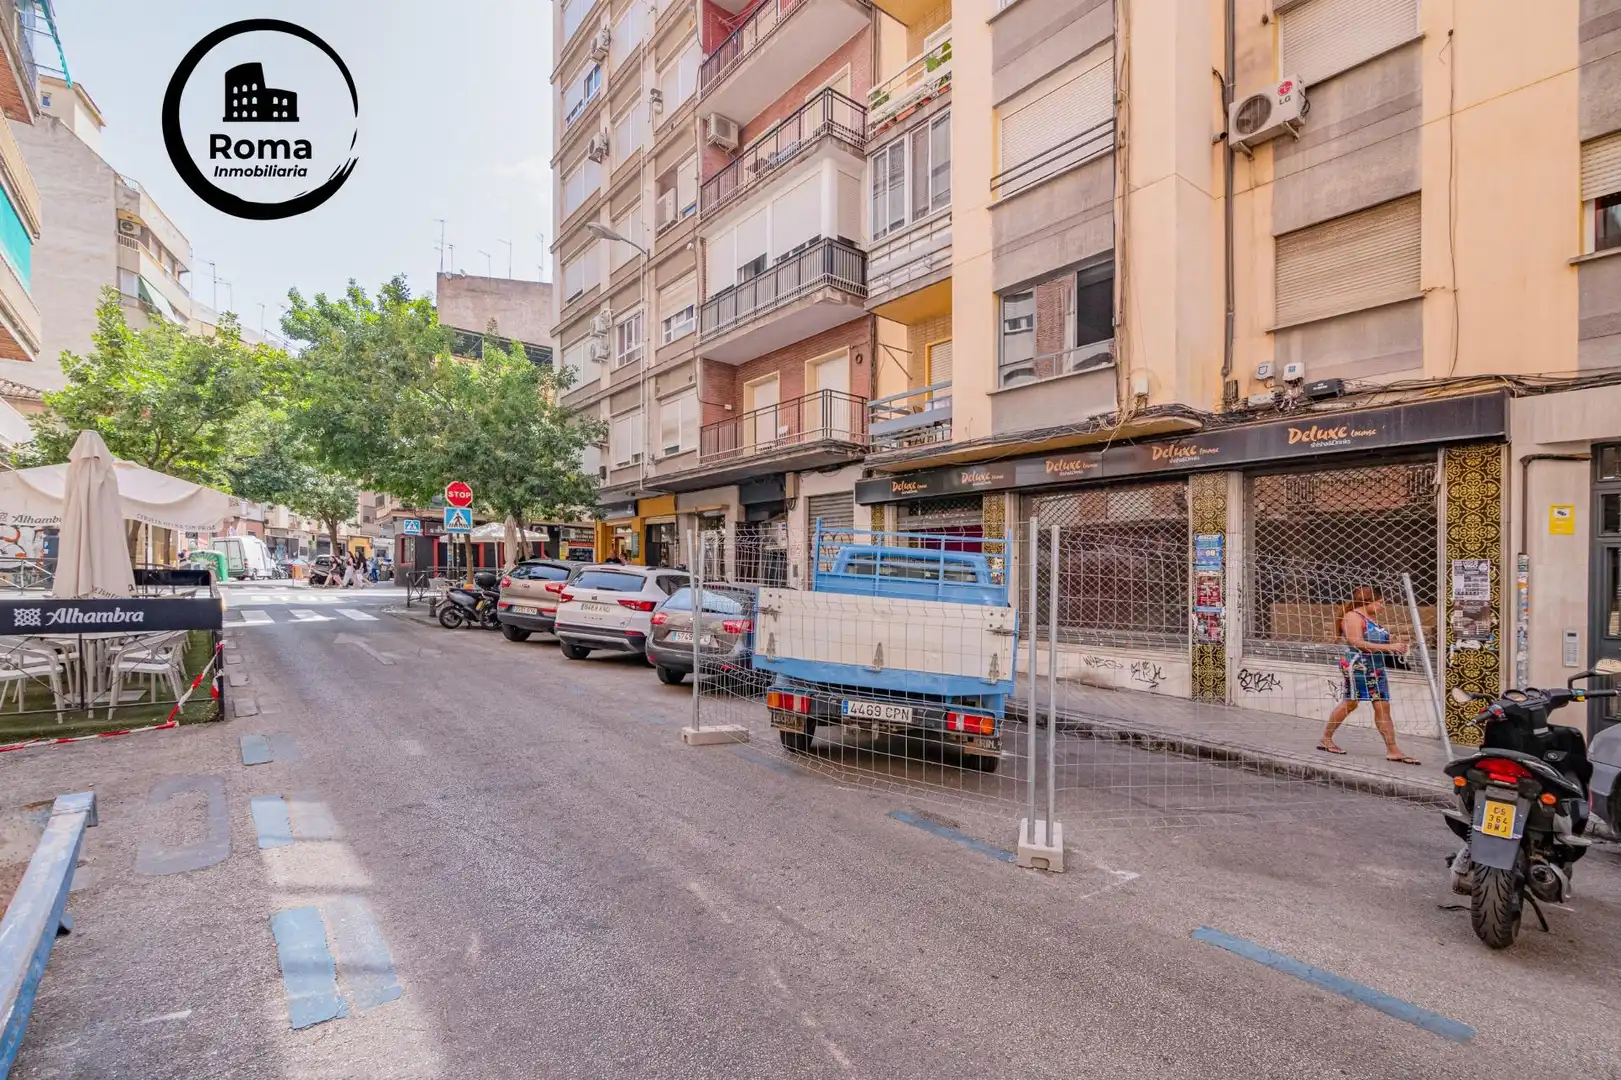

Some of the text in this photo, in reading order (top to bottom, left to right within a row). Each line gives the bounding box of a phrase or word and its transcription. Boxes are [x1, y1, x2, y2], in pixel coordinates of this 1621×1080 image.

[1279, 95, 1291, 105] LG
[1288, 425, 1348, 445] Deluxe
[1151, 444, 1197, 461] Deluxe
[1045, 459, 1081, 474] Deluxe
[961, 470, 990, 484] Deluxe
[891, 480, 917, 492] Deluxe
[448, 490, 471, 499] STOP
[45, 607, 144, 626] Alhambra
[850, 702, 909, 720] 4469 CPN
[1488, 814, 1508, 825] 364
